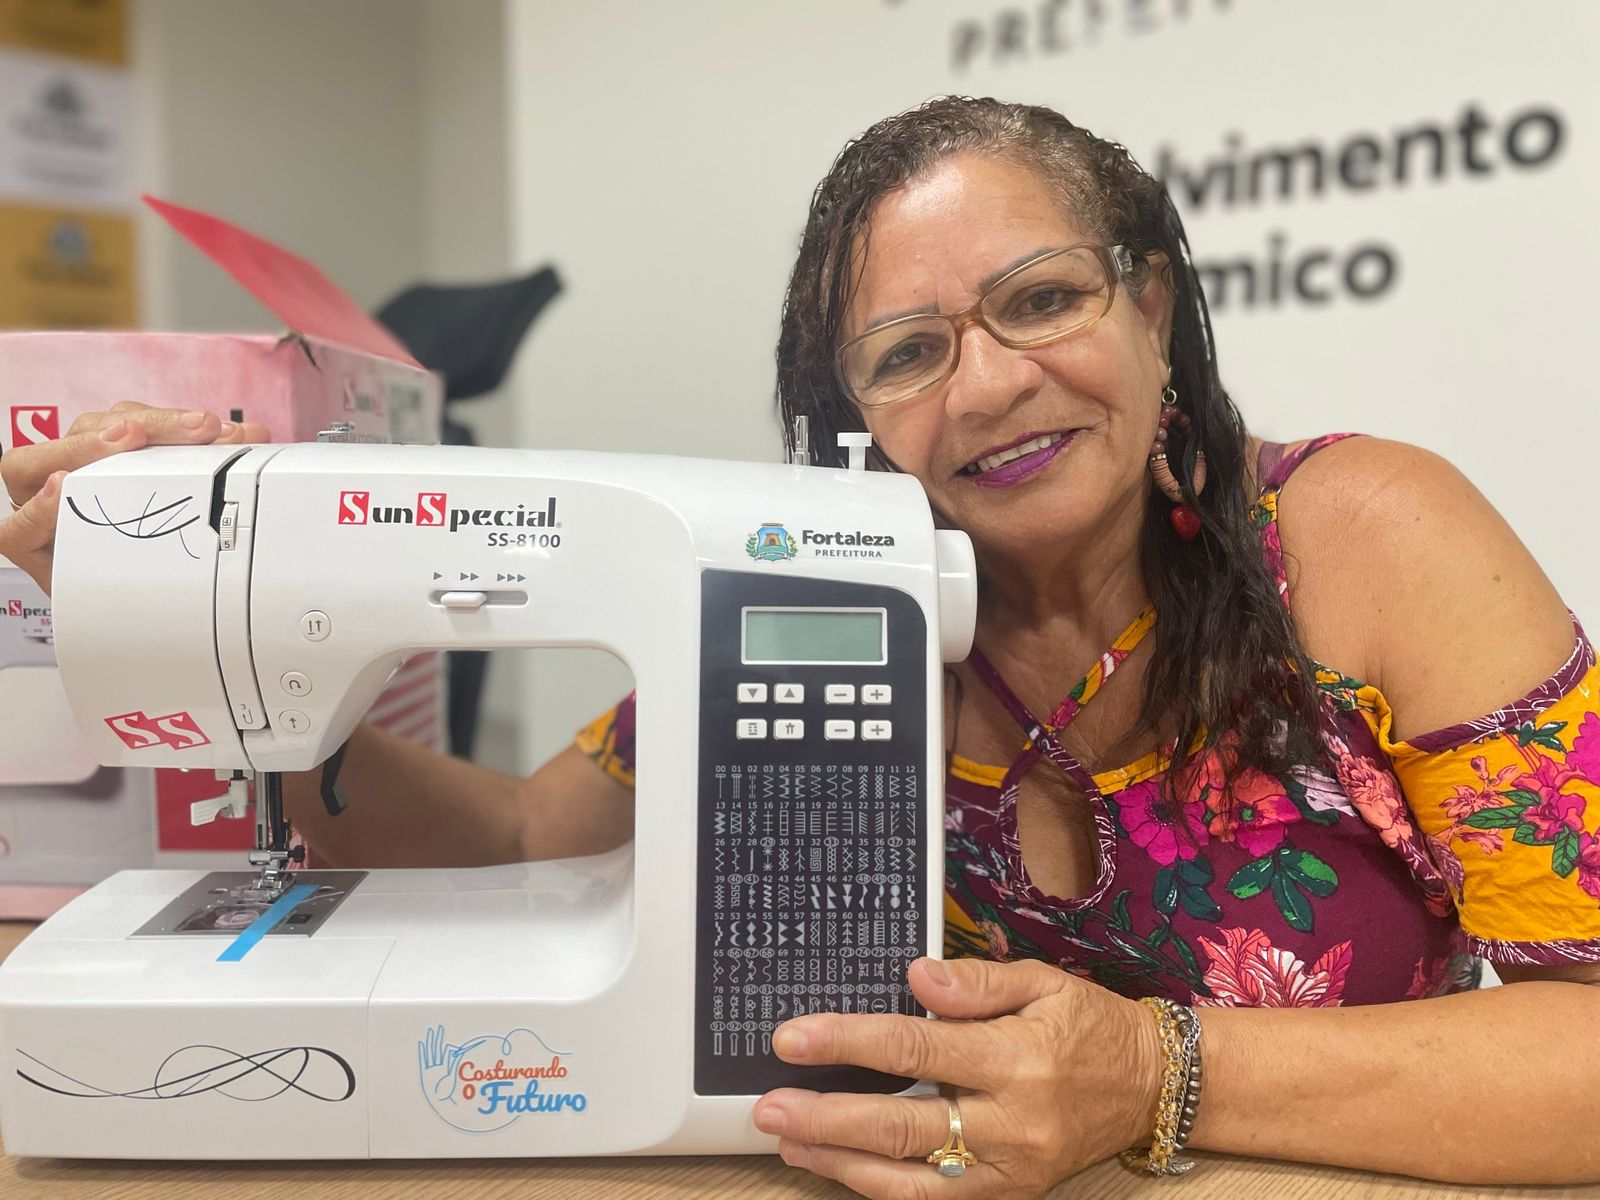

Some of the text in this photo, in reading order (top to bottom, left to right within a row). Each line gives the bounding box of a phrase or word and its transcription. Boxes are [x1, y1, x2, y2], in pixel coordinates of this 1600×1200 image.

[487, 532, 561, 548] SS-8100
[801, 529, 895, 547] Fortaleza
[224, 540, 230, 549] 5
[815, 549, 883, 558] PREFEITURA
[715, 765, 916, 773] 00 01 02 03 04 05 06 07 08 09 10 11 12
[716, 801, 726, 809] 13
[748, 801, 758, 809] 15
[764, 801, 774, 809] 16
[780, 801, 789, 809] 17
[796, 801, 805, 809] 18
[812, 801, 821, 809] 19
[827, 801, 837, 809] 20
[842, 801, 852, 809] 21
[858, 801, 869, 809] 22
[874, 801, 885, 809] 23
[890, 801, 900, 809] 24
[906, 801, 916, 810] 25
[715, 838, 725, 846] 26
[731, 838, 741, 846] 27
[747, 838, 757, 846] 28
[779, 838, 789, 846] 30
[795, 838, 804, 846] 31
[811, 838, 821, 846] 32
[843, 838, 853, 846] 34
[858, 838, 869, 846] 35
[874, 838, 885, 846] 36
[906, 838, 916, 846] 38
[715, 875, 725, 883] 39
[762, 875, 773, 883] 42
[778, 875, 789, 883] 43
[810, 875, 821, 883] 45
[826, 875, 837, 883] 46
[906, 875, 916, 883] 51
[714, 912, 724, 920] 52
[730, 912, 741, 920] 53
[746, 912, 757, 920] 54
[762, 912, 773, 920] 55
[778, 912, 789, 920] 56
[794, 912, 805, 920] 57
[810, 912, 821, 920] 58
[826, 912, 837, 920] 59
[842, 912, 853, 920] 60
[858, 911, 868, 920] 61
[874, 911, 885, 920] 62
[890, 911, 900, 920] 63
[713, 949, 724, 957] 65
[778, 949, 789, 957] 69
[794, 949, 805, 957] 70
[810, 949, 820, 957] 71
[826, 948, 836, 957] 72
[714, 986, 724, 994] 78
[730, 986, 740, 994] 79
[458, 1056, 568, 1082] Costurando
[478, 1079, 587, 1115] Futuro
